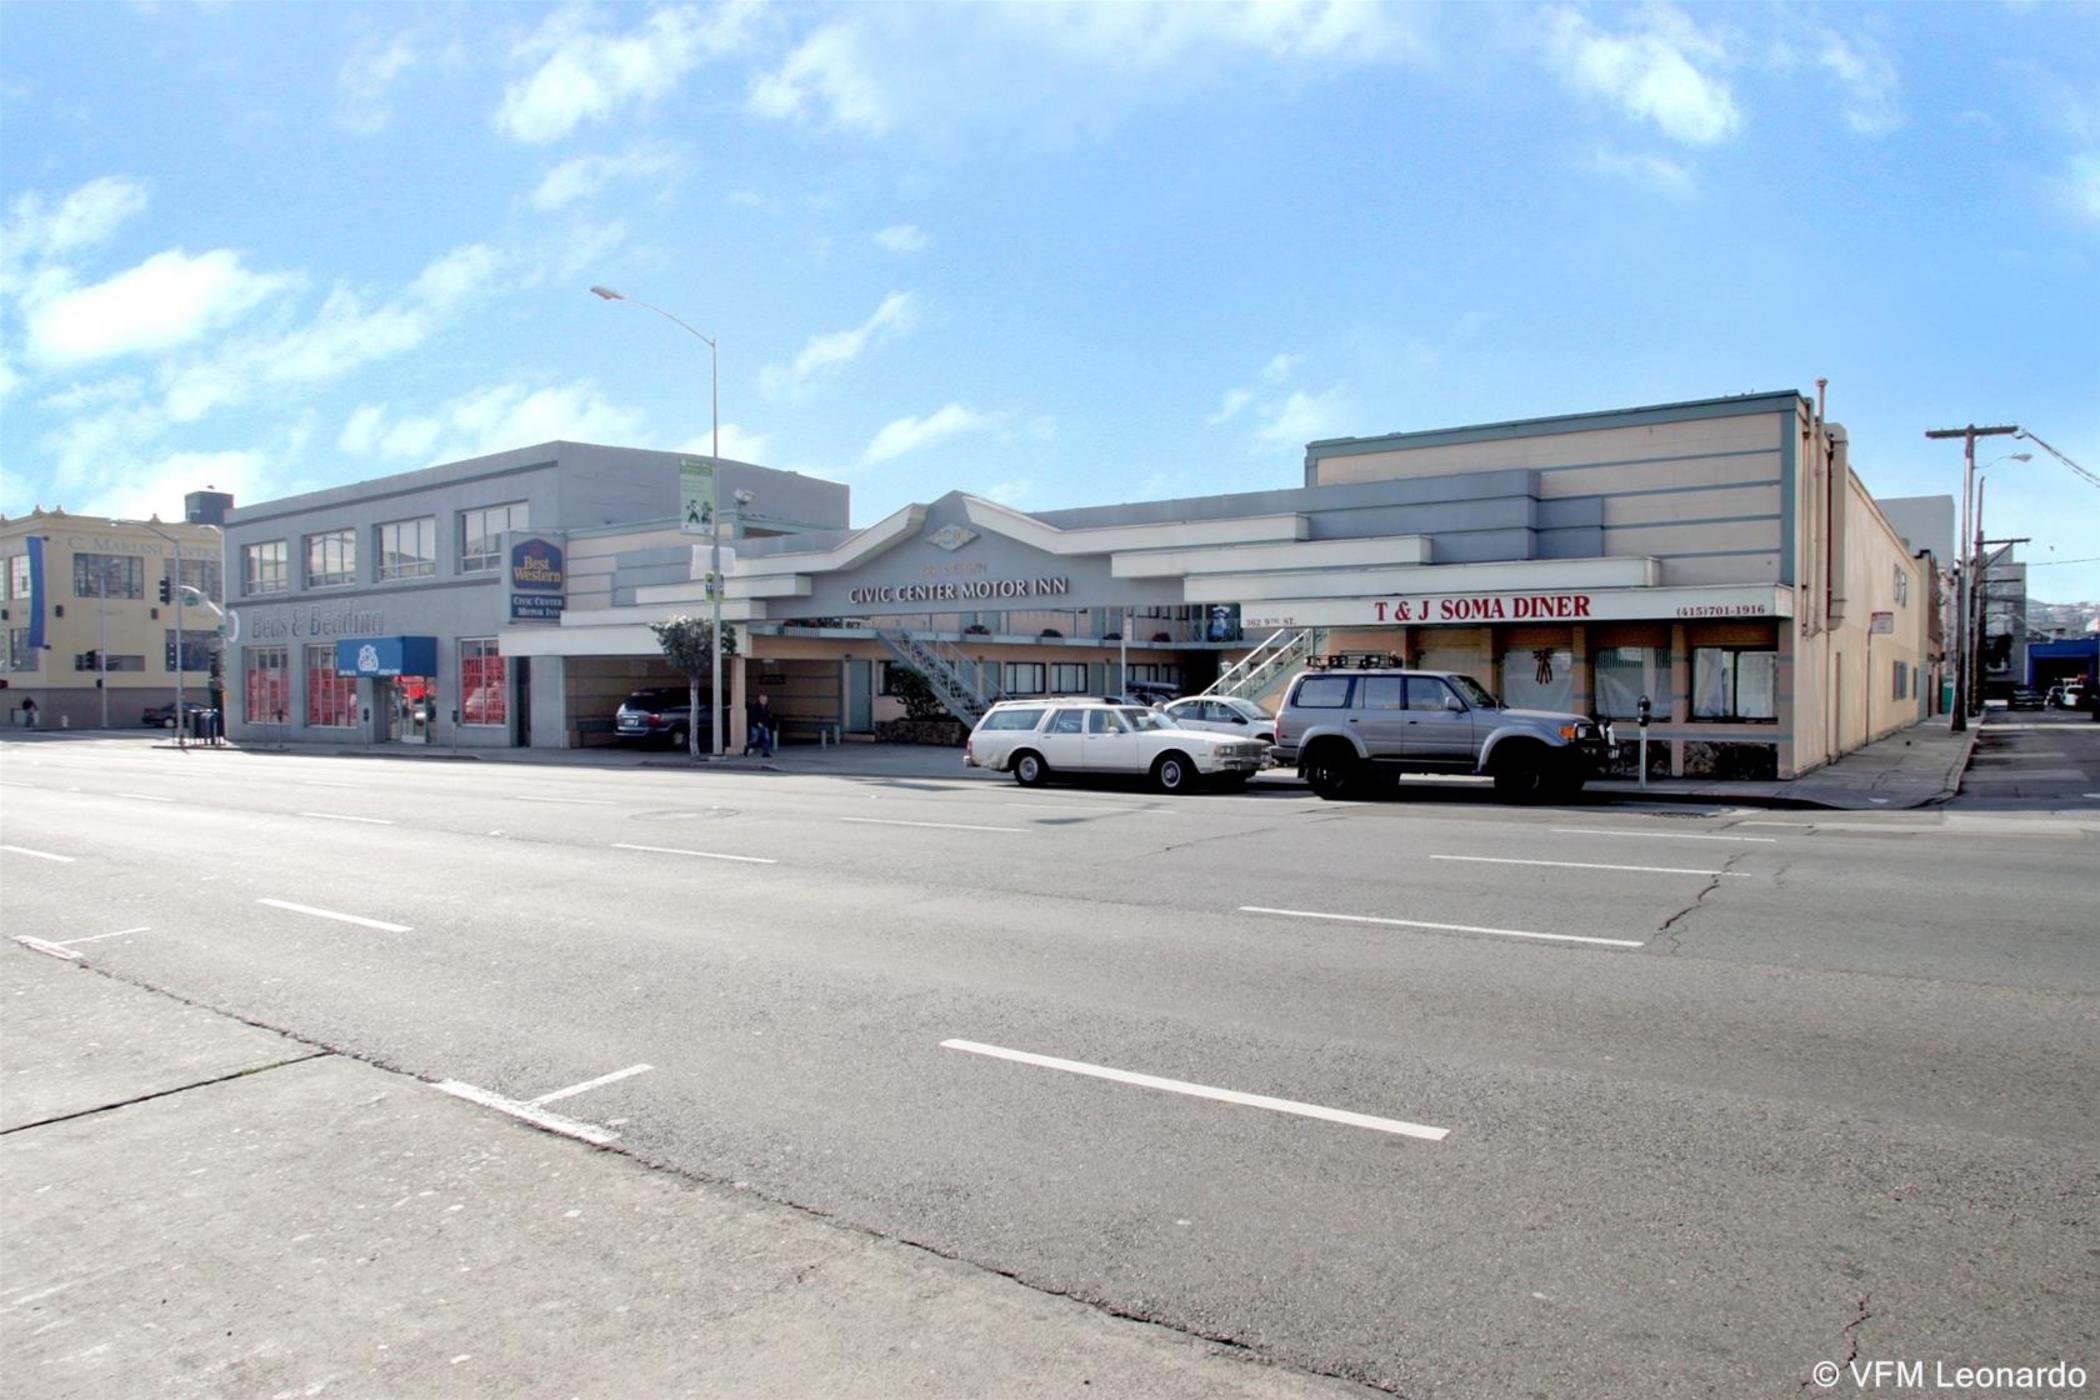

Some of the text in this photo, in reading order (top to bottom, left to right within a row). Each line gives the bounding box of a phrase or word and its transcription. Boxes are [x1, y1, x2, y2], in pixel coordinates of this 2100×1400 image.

[524, 555, 550, 570] Best
[513, 566, 561, 582] Western
[849, 576, 1069, 604] CIVIC CENTER MOTOR INN
[1374, 595, 1591, 621] T & J SOMA DINER
[1676, 604, 1766, 617] (415)701-1916
[252, 605, 288, 639] Beds
